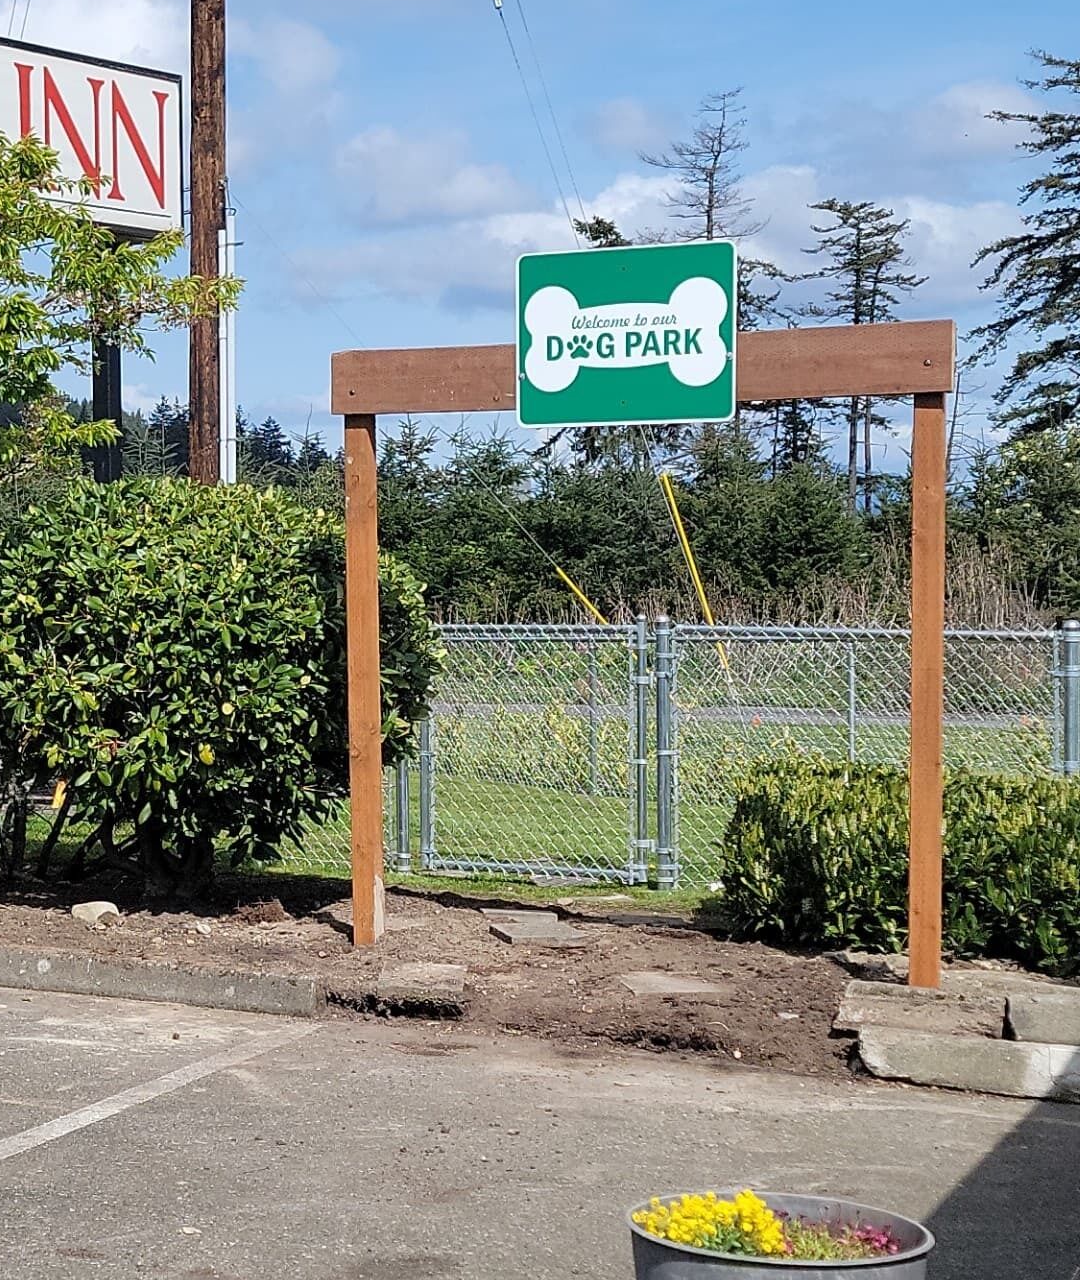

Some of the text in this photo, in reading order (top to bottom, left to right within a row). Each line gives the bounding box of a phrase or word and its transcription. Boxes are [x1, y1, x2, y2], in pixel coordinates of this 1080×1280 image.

[14, 62, 170, 210] INN
[571, 313, 678, 330] Welcome to our
[546, 327, 703, 361] DG PARK
